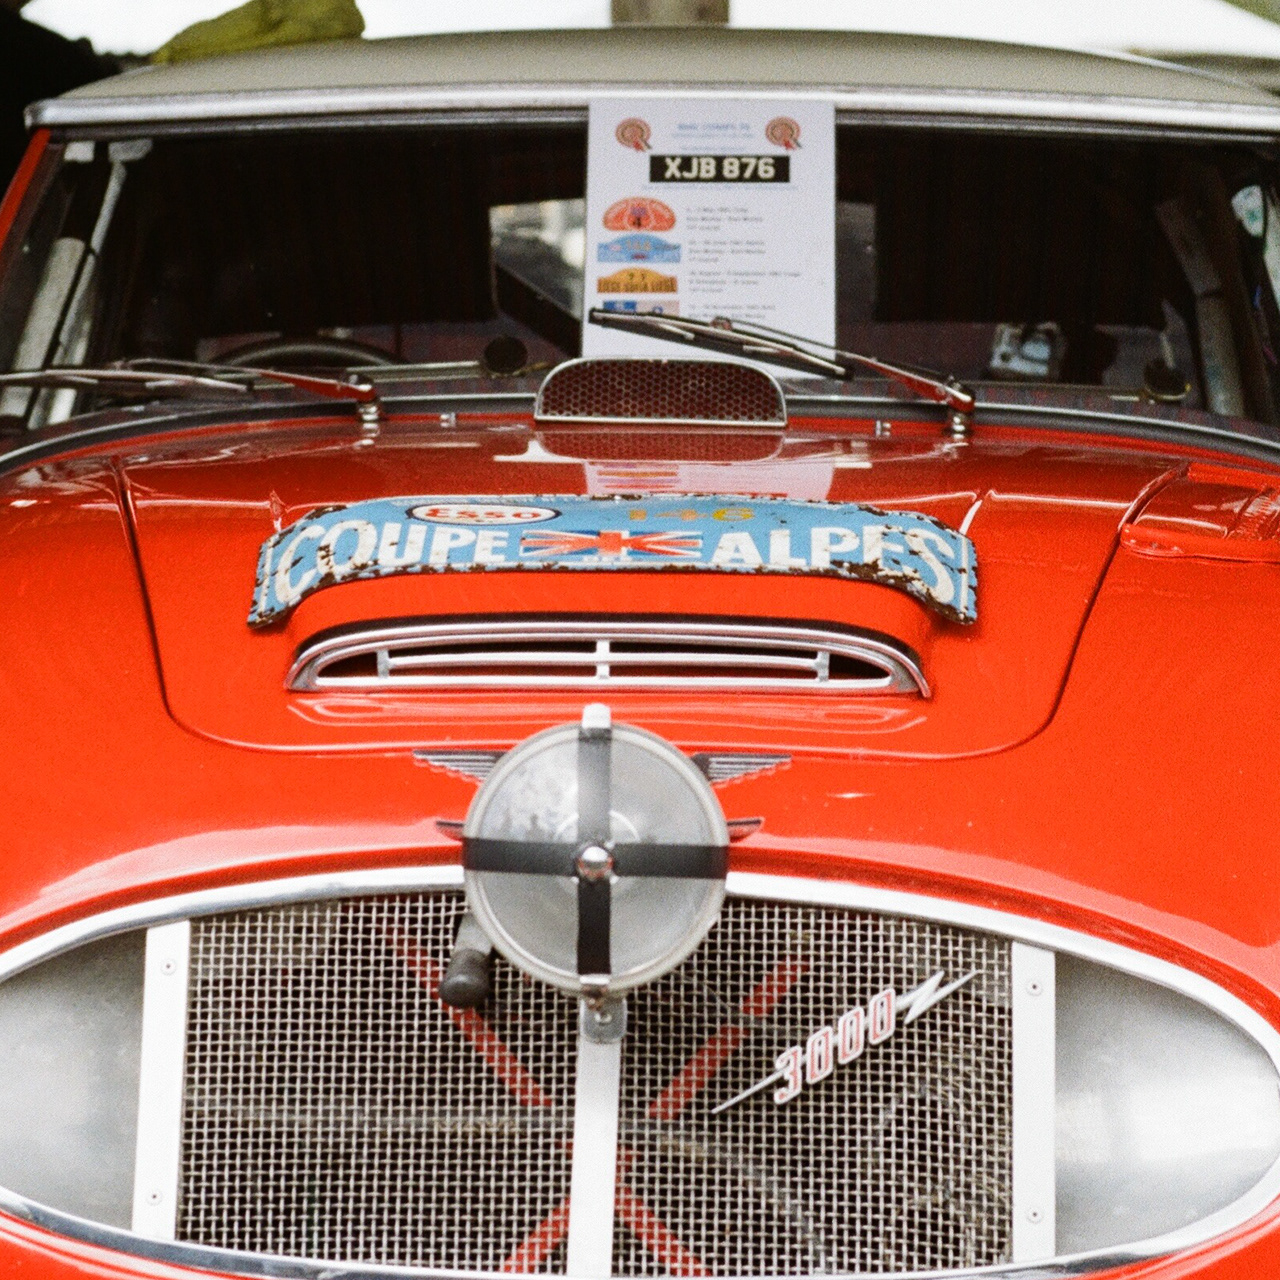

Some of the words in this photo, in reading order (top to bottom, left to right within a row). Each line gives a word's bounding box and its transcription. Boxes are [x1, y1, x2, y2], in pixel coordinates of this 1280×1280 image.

[664, 157, 717, 180] XJB
[722, 157, 776, 180] 876
[274, 518, 510, 606] COUPE
[670, 524, 956, 604] ALPES
[773, 987, 896, 1106] 3000
